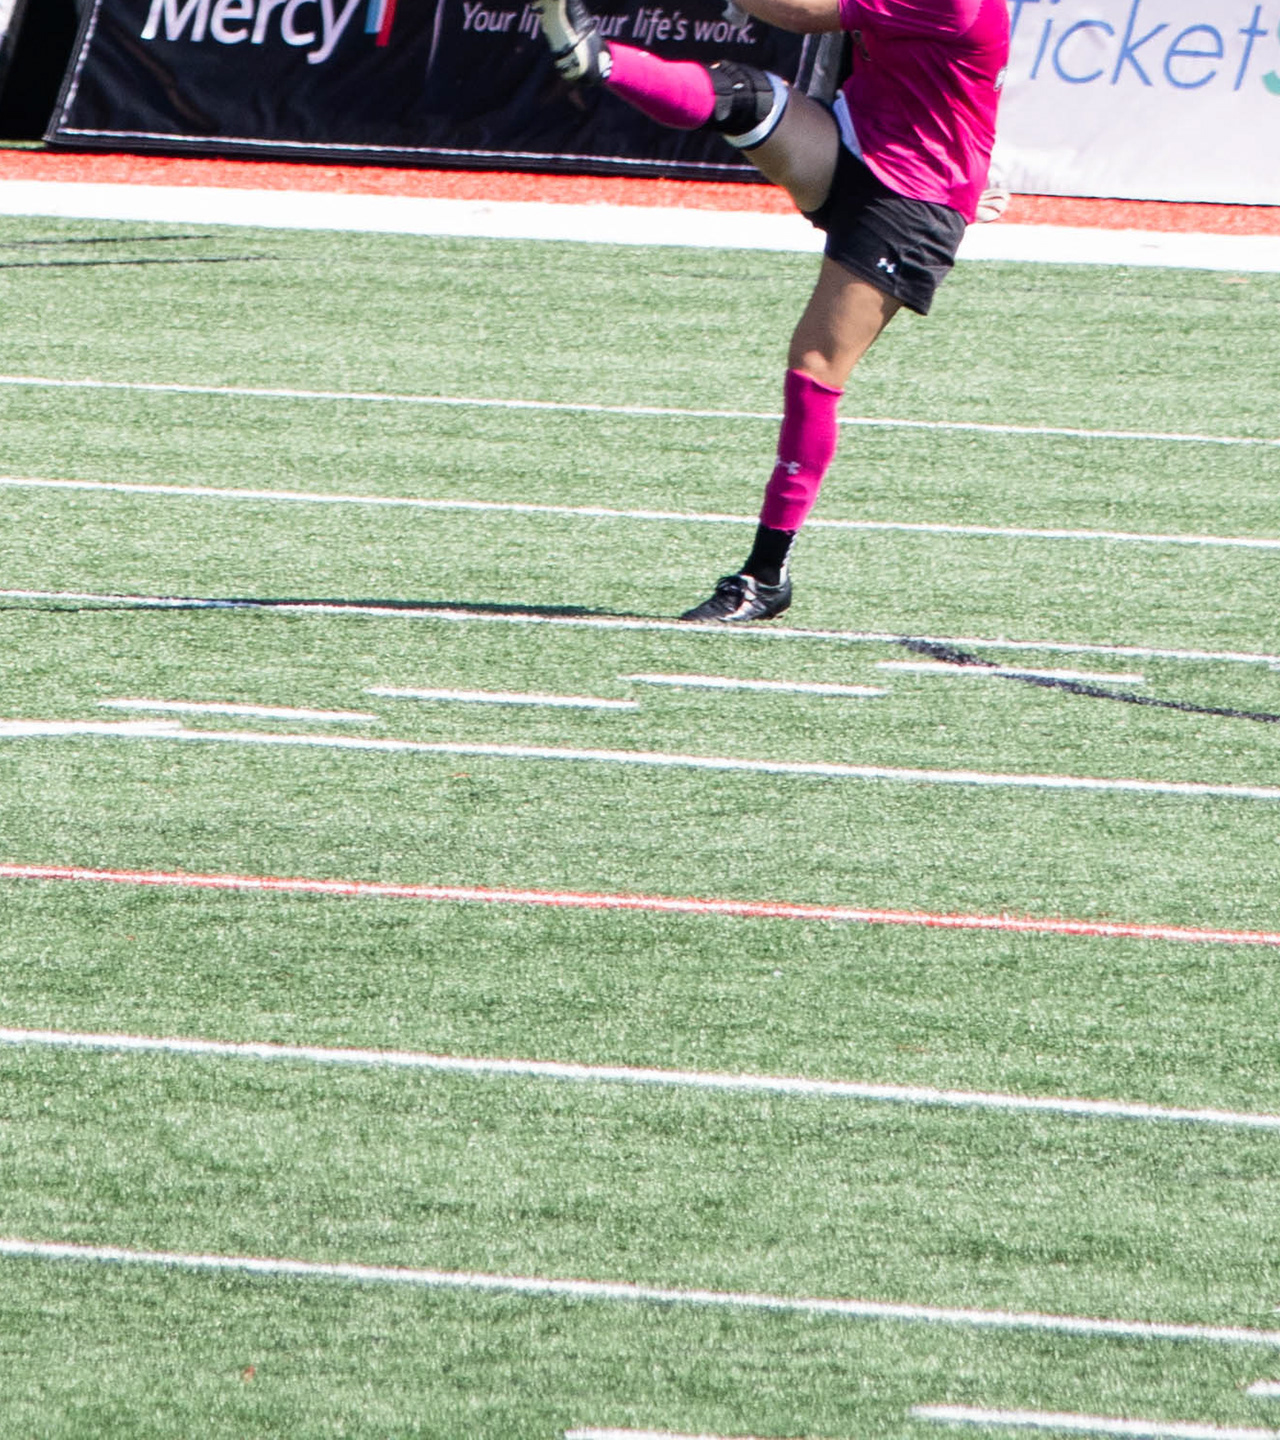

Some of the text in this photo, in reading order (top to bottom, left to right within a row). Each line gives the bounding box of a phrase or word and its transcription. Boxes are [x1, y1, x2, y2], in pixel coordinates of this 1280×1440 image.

[462, 1, 517, 32] Your
[632, 6, 687, 46] life's
[693, 16, 757, 44] work.
